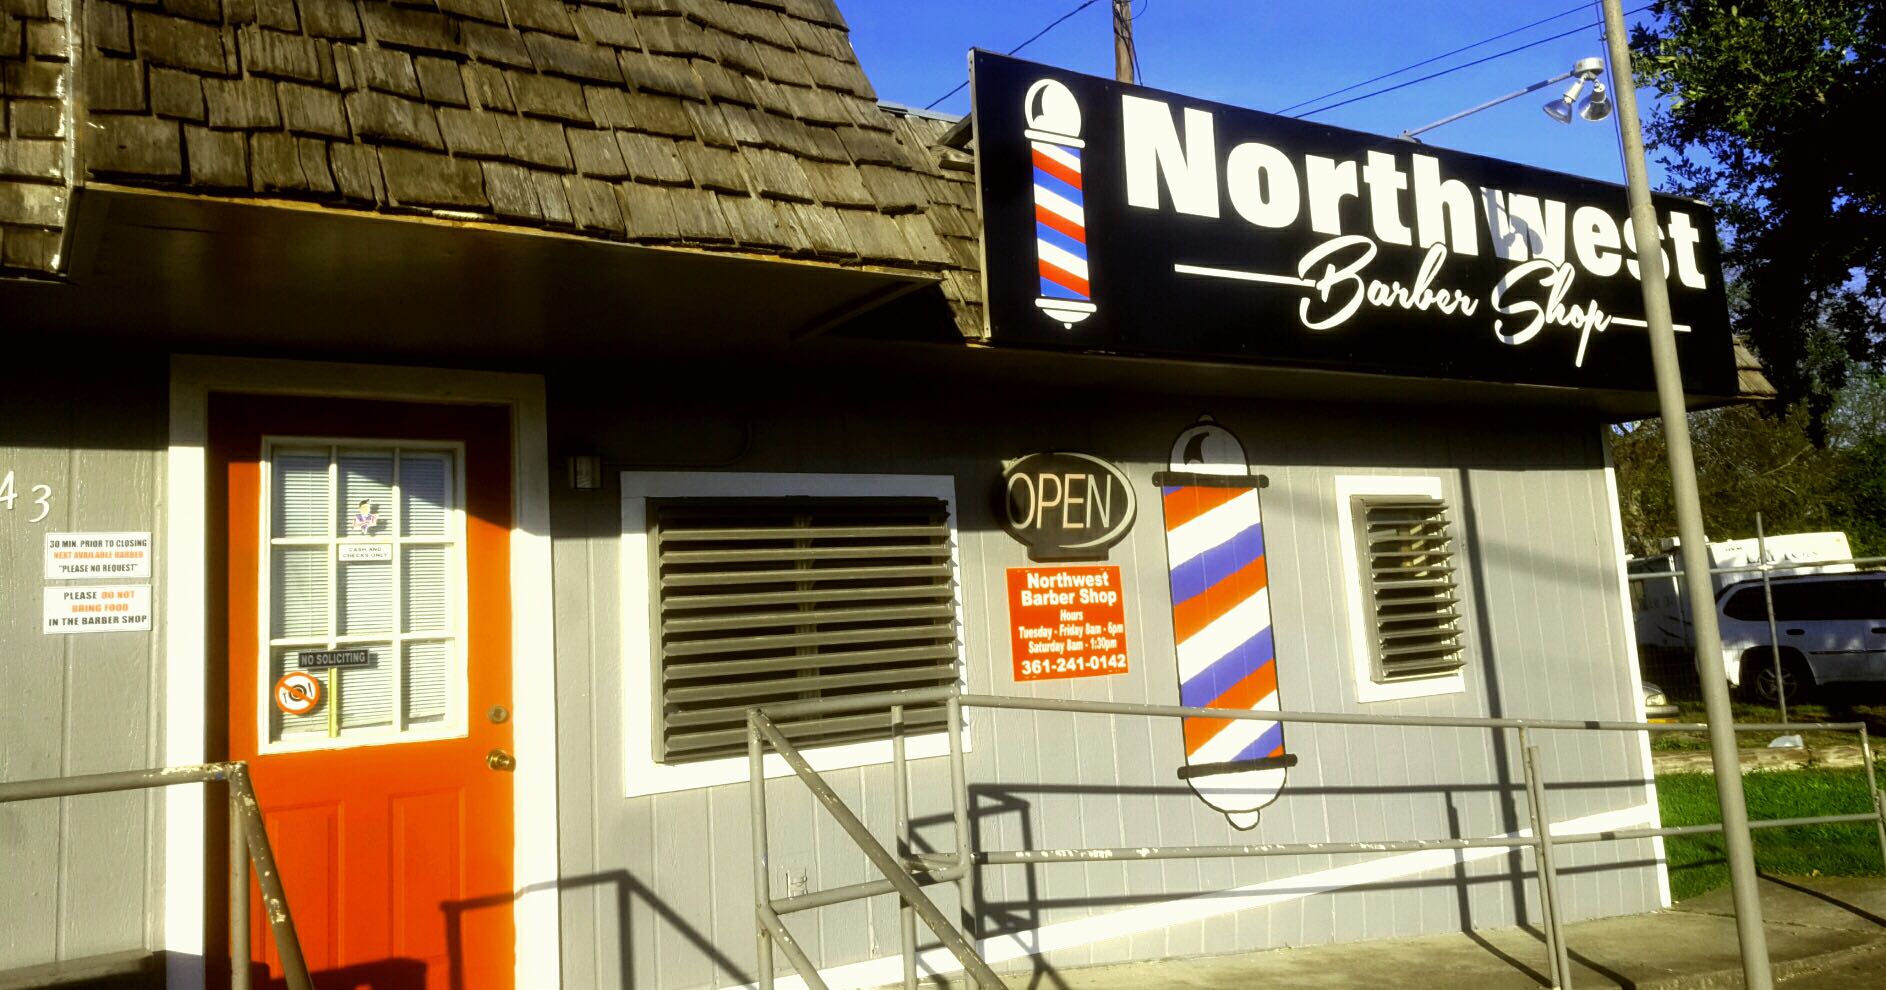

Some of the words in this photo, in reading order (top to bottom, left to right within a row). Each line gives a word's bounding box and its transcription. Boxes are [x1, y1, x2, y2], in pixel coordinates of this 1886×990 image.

[1298, 234, 1478, 331] Barber
[1491, 259, 1613, 368] Shop
[1006, 472, 1112, 530] OPEN
[49, 540, 60, 548] 30
[62, 540, 79, 548] MIN.
[80, 539, 103, 548] PRIOR
[105, 539, 114, 548] TO
[116, 539, 147, 548] CLOSING
[54, 551, 72, 559] NEXT
[73, 551, 113, 559] AVAILABLE
[90, 564, 101, 572] NO
[1027, 572, 1109, 588] Northwest
[63, 591, 97, 600] PLEASE
[101, 591, 114, 599] DO
[117, 591, 135, 599] NOT
[1021, 589, 1076, 606] Barber
[1079, 588, 1117, 606] Shop
[71, 604, 102, 613] BRING
[104, 603, 129, 611] FOOD
[48, 618, 59, 626] IN
[62, 617, 79, 626] THE
[81, 616, 120, 625] BARBER
[122, 615, 147, 624] SHOP
[1060, 609, 1084, 621] Hours
[1018, 626, 1053, 640] Tuesday
[1060, 624, 1084, 638] Friday
[1085, 623, 1102, 635] 8am
[1107, 621, 1124, 636] 6pm
[1028, 641, 1065, 655] Saturday
[1066, 639, 1084, 651] 8am
[1090, 637, 1117, 651] 1:30pm
[301, 654, 314, 665] NO
[316, 652, 365, 665] SOLICITING
[1021, 654, 1127, 675] 361-241-0142
